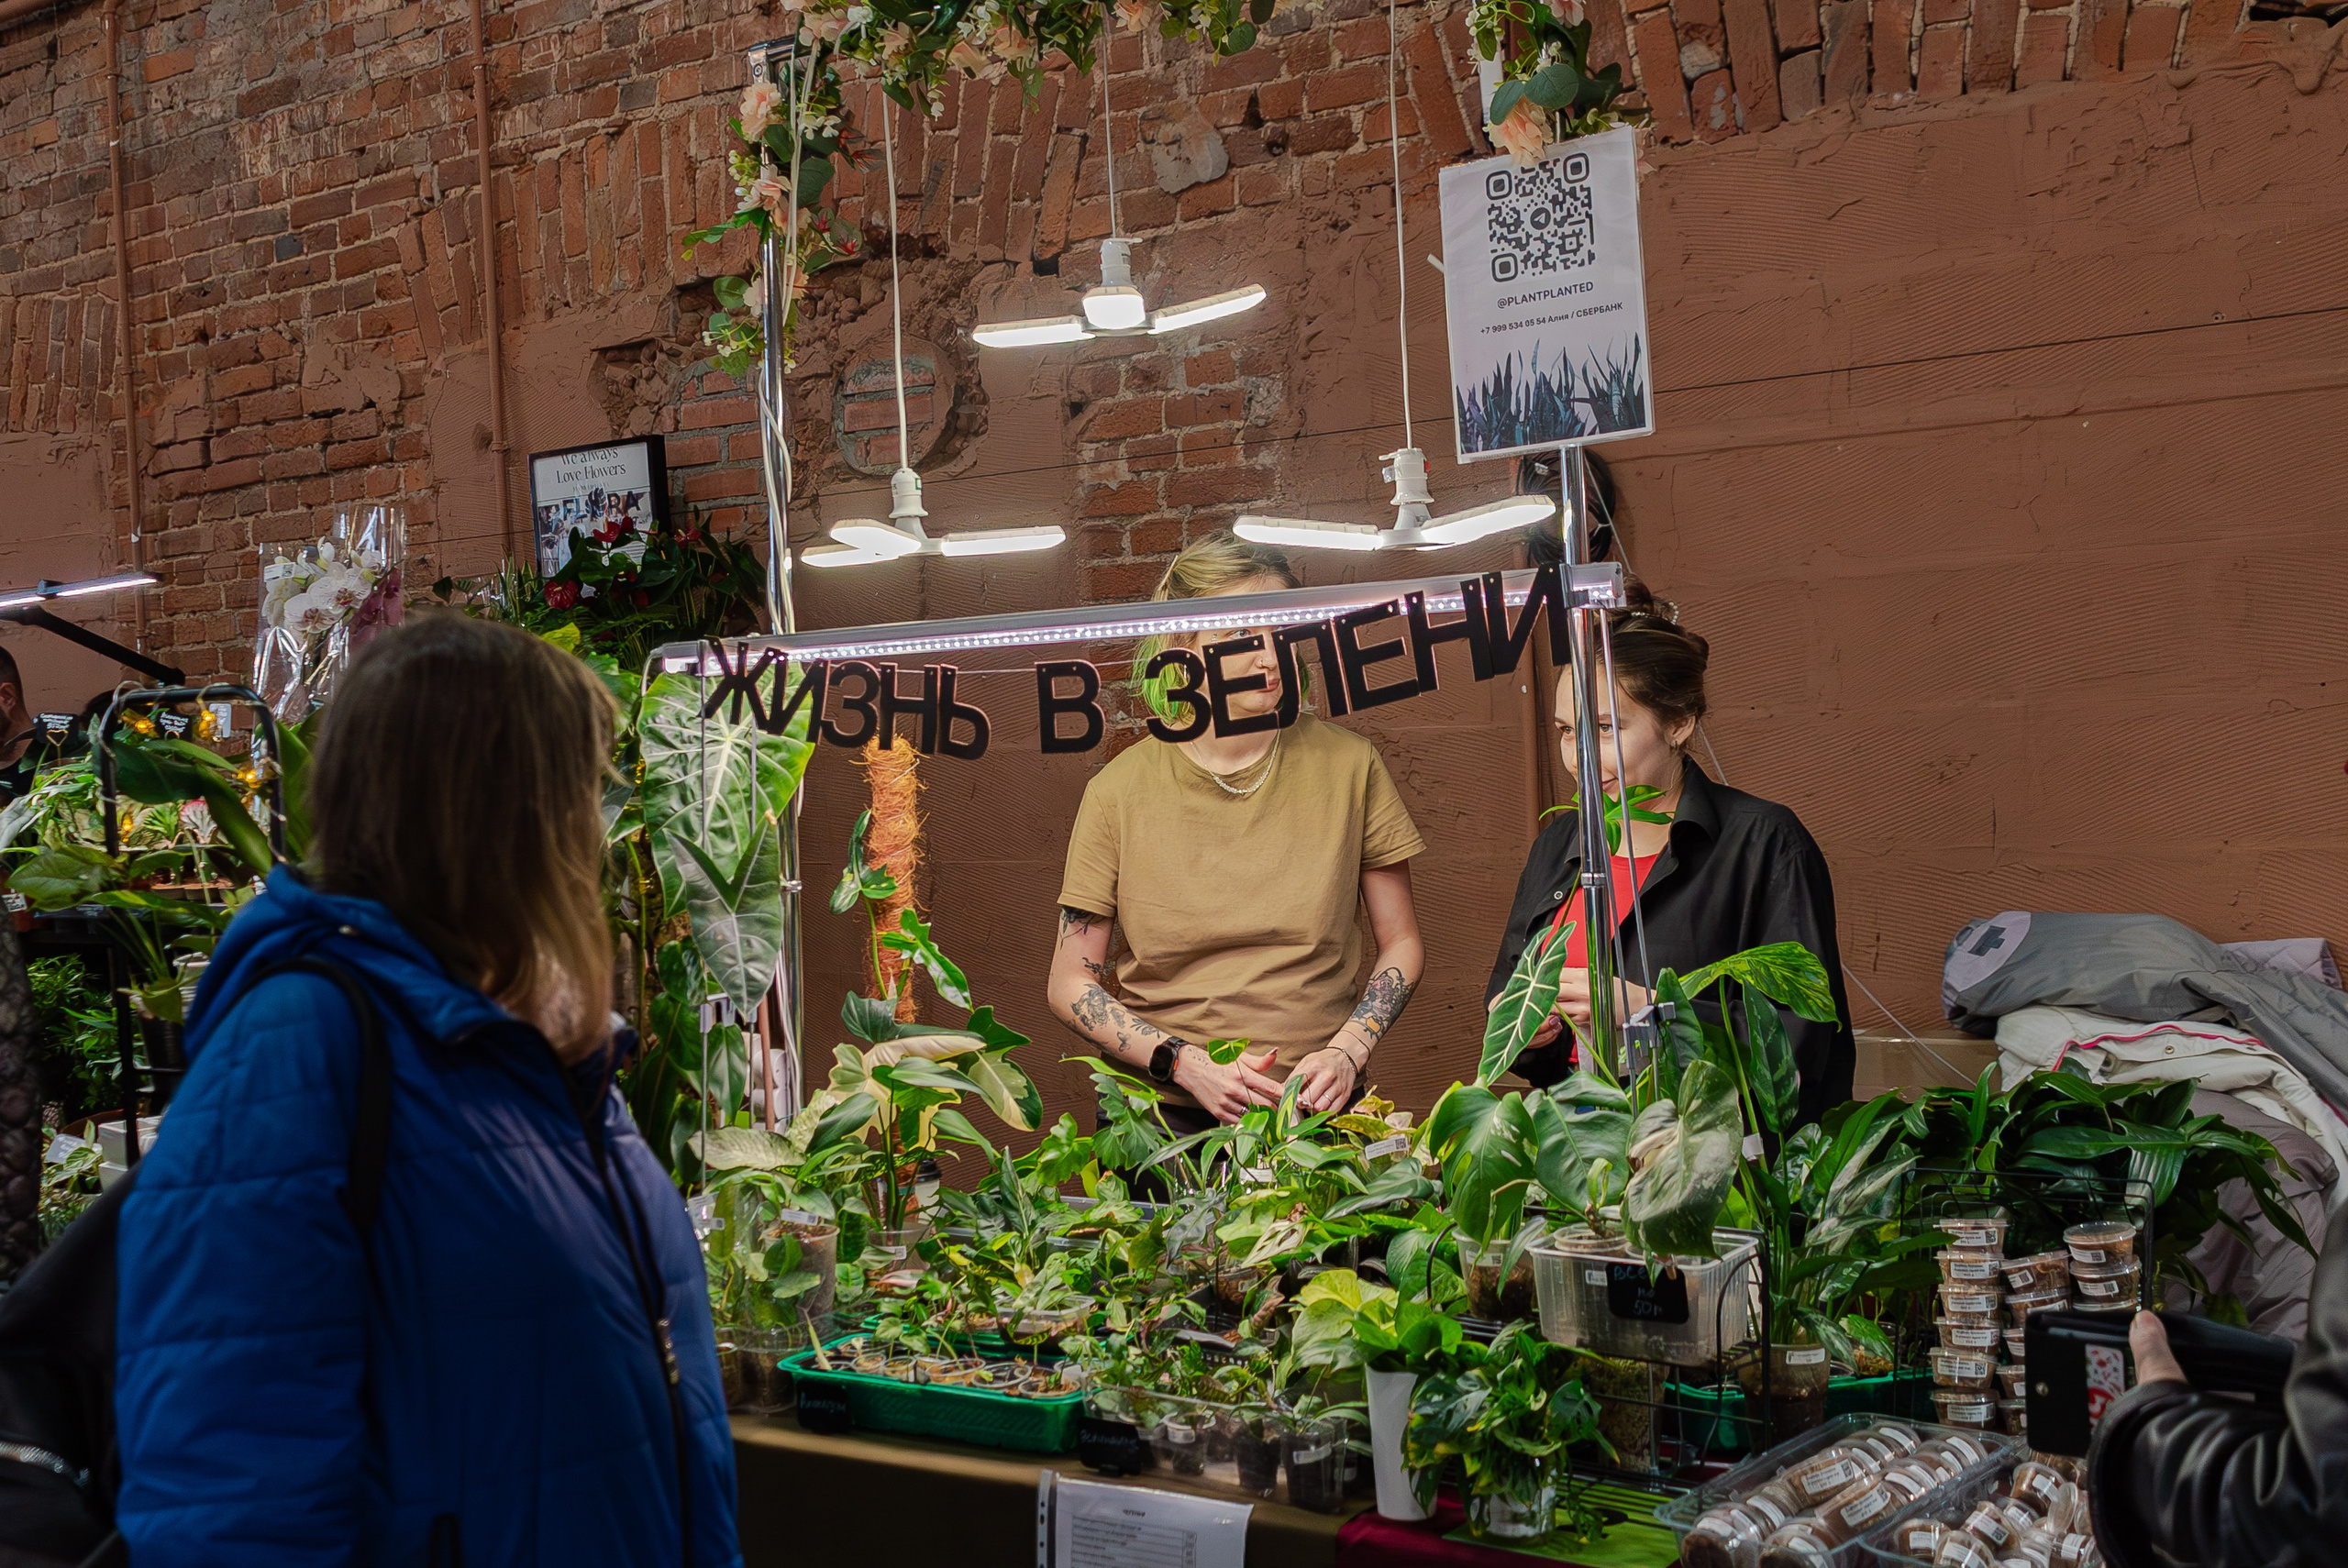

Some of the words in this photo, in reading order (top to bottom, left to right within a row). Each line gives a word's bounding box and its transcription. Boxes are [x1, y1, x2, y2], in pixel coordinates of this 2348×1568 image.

[1497, 281, 1594, 309] @PLANTPLANTED
[1480, 326, 1490, 335] +7
[1491, 323, 1507, 334] 999
[1509, 320, 1523, 331] 534
[1524, 319, 1534, 327] 05
[1535, 316, 1546, 326] 54
[1576, 302, 1623, 318] СБЕРБАНК
[556, 470, 581, 484] Love
[583, 463, 626, 480] Flowers
[697, 634, 991, 759] ЖИЗНЬ
[1035, 659, 1105, 754] В
[1144, 562, 1572, 744] ЗЕЛЕНИ
